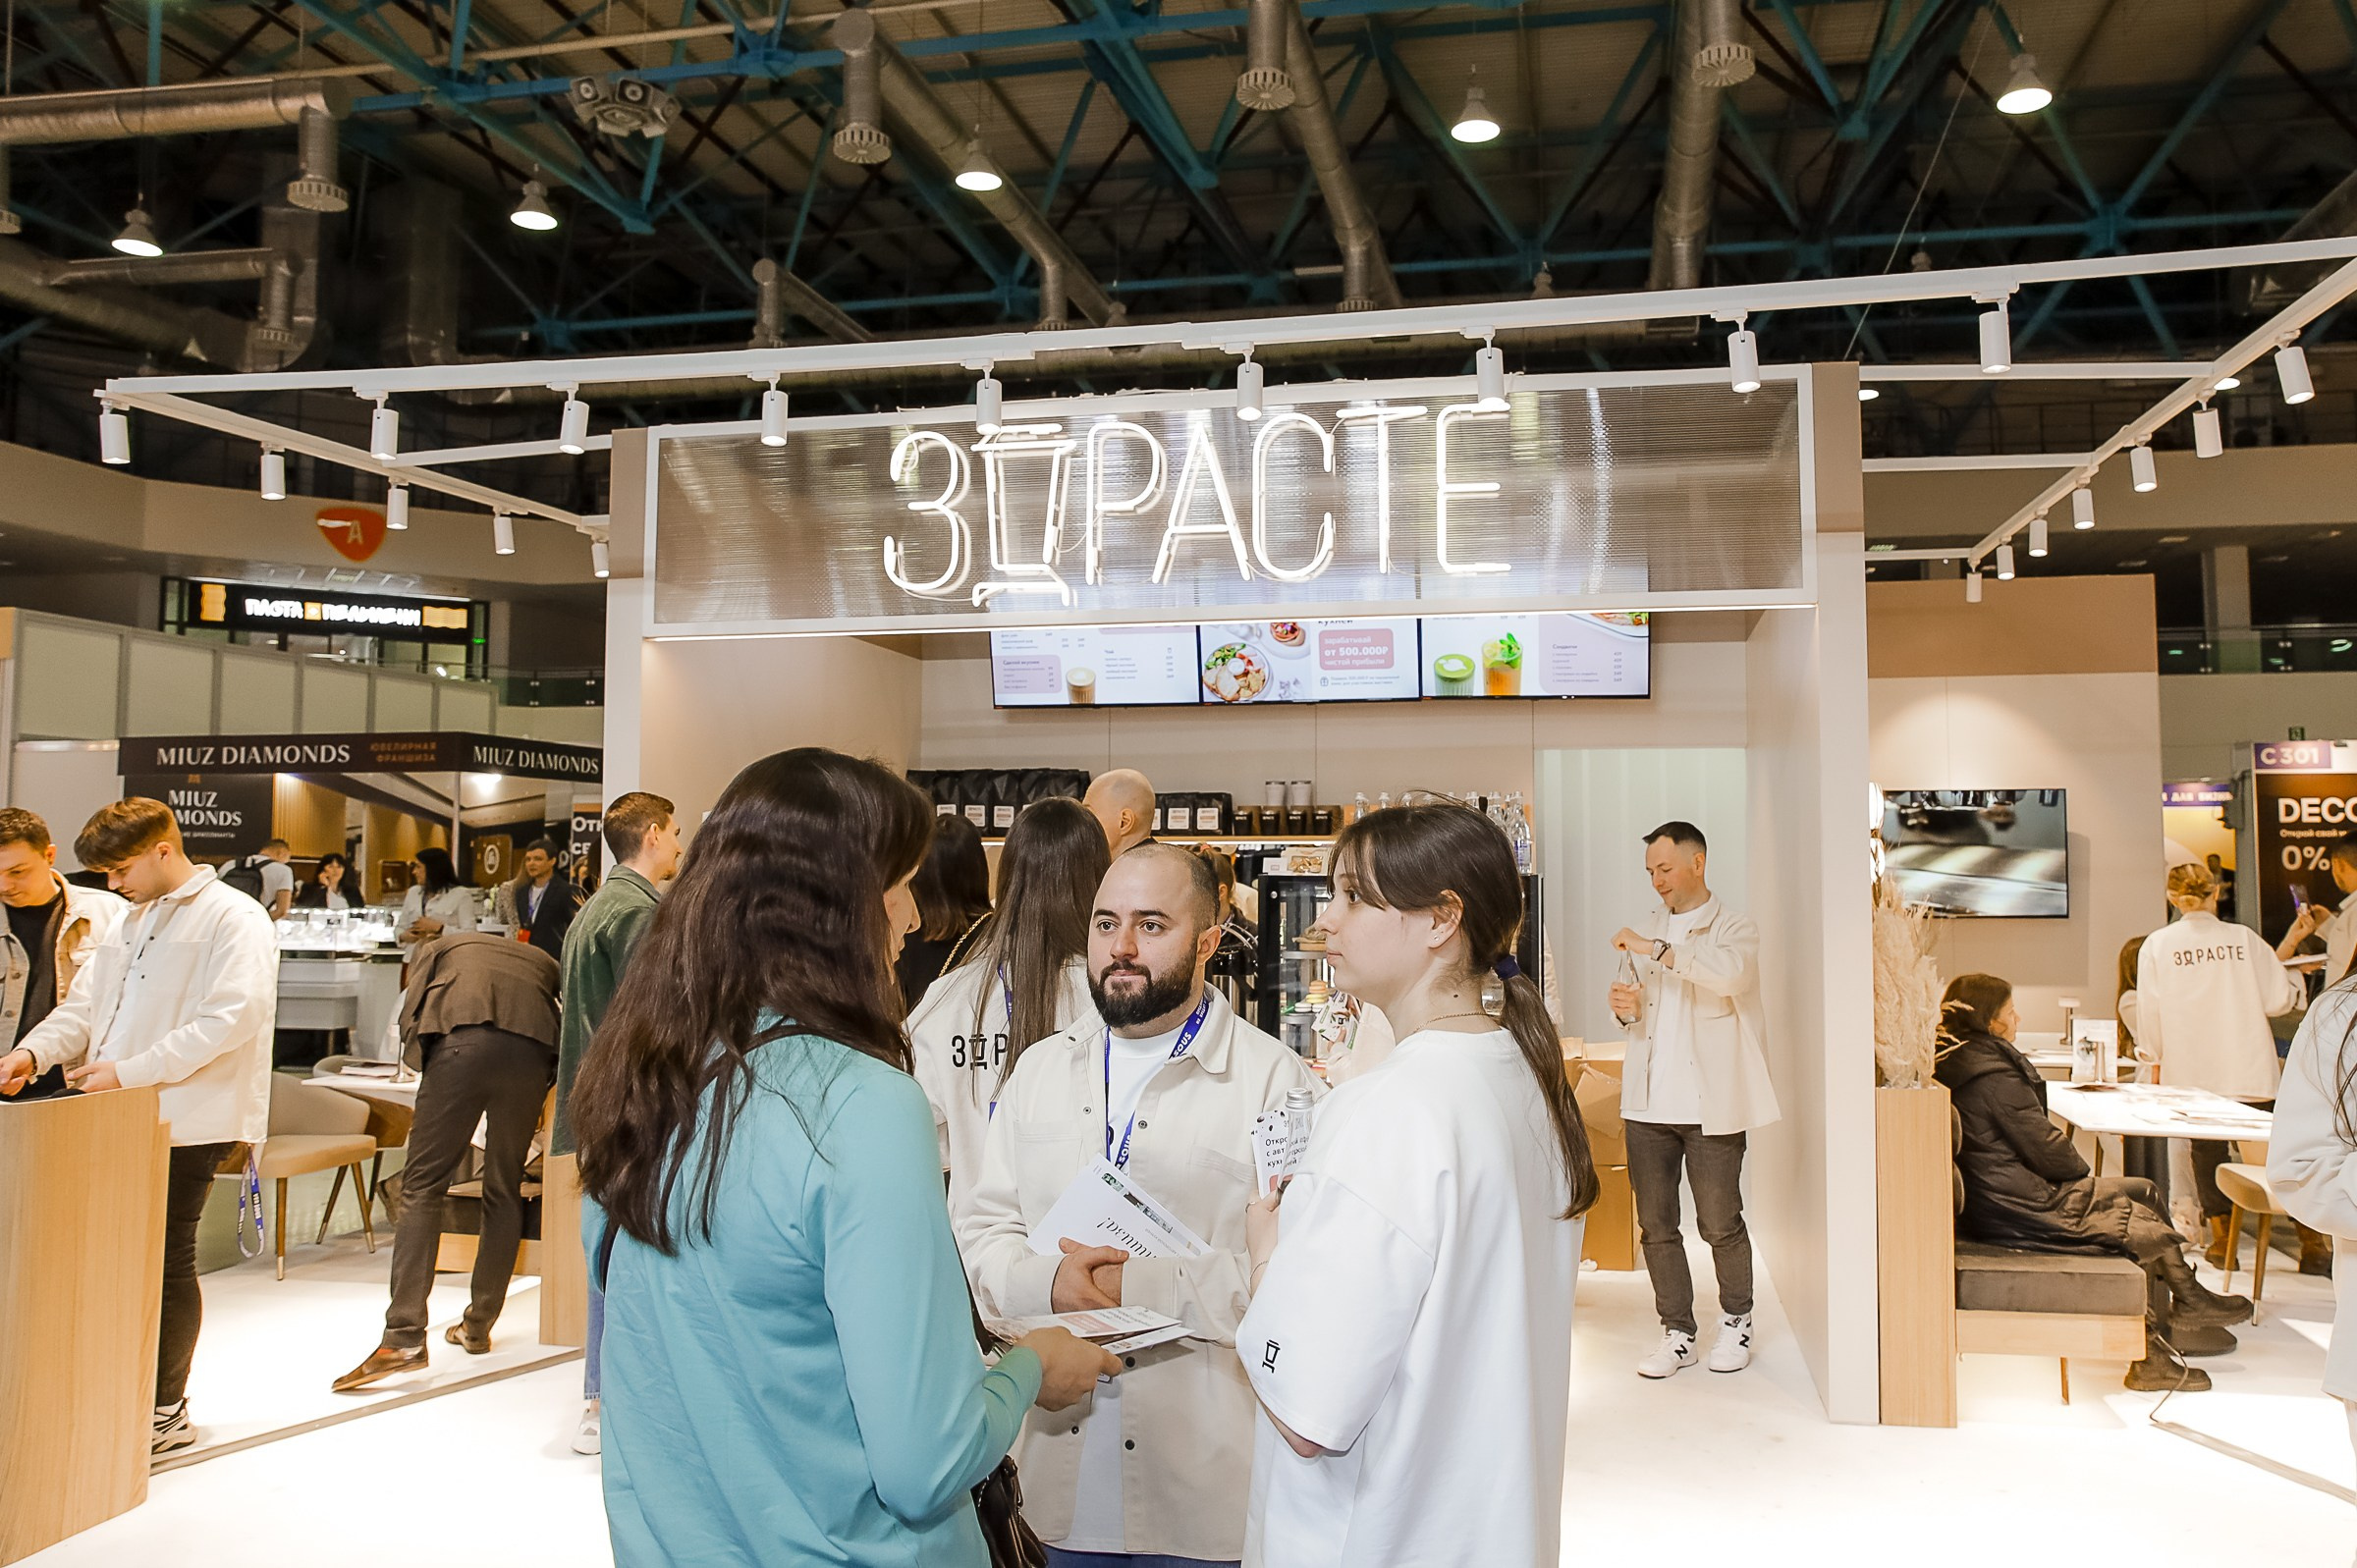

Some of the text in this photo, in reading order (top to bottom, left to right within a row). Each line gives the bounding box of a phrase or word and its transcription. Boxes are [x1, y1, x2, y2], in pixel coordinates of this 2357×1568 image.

[1324, 648, 1336, 657] от
[156, 744, 351, 766] MIUZ DIAMONDS
[376, 753, 436, 763] ФРАНШИЗА
[473, 745, 599, 775] MIUZ DIAMONDS
[168, 789, 218, 808] MIUZ
[175, 810, 243, 827] MONDS
[2281, 845, 2330, 872] 0%
[1174, 1031, 1192, 1056] SOUS
